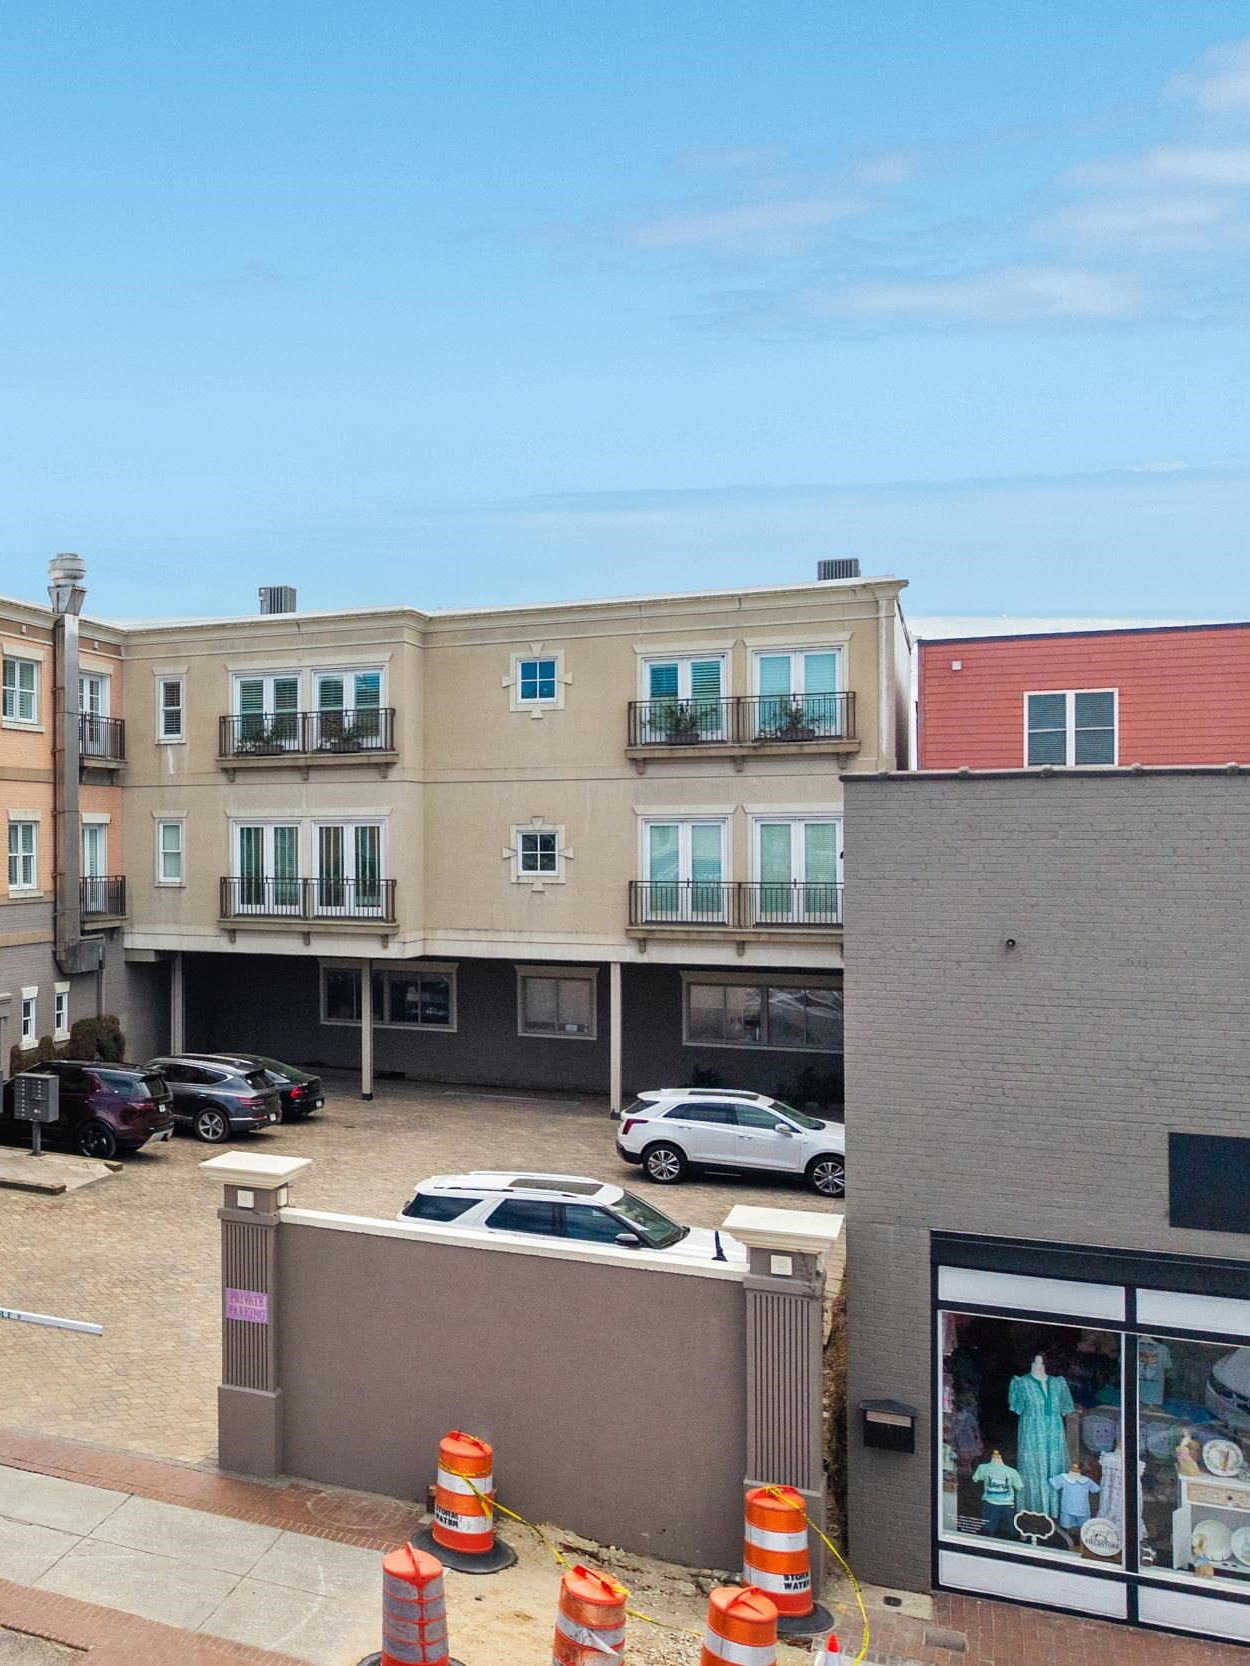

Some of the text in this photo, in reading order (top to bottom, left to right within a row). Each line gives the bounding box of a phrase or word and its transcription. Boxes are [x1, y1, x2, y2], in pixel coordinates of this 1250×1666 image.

[229, 1291, 265, 1308] PRIVATE
[228, 1303, 266, 1322] PARKING
[435, 1504, 459, 1520] STORM
